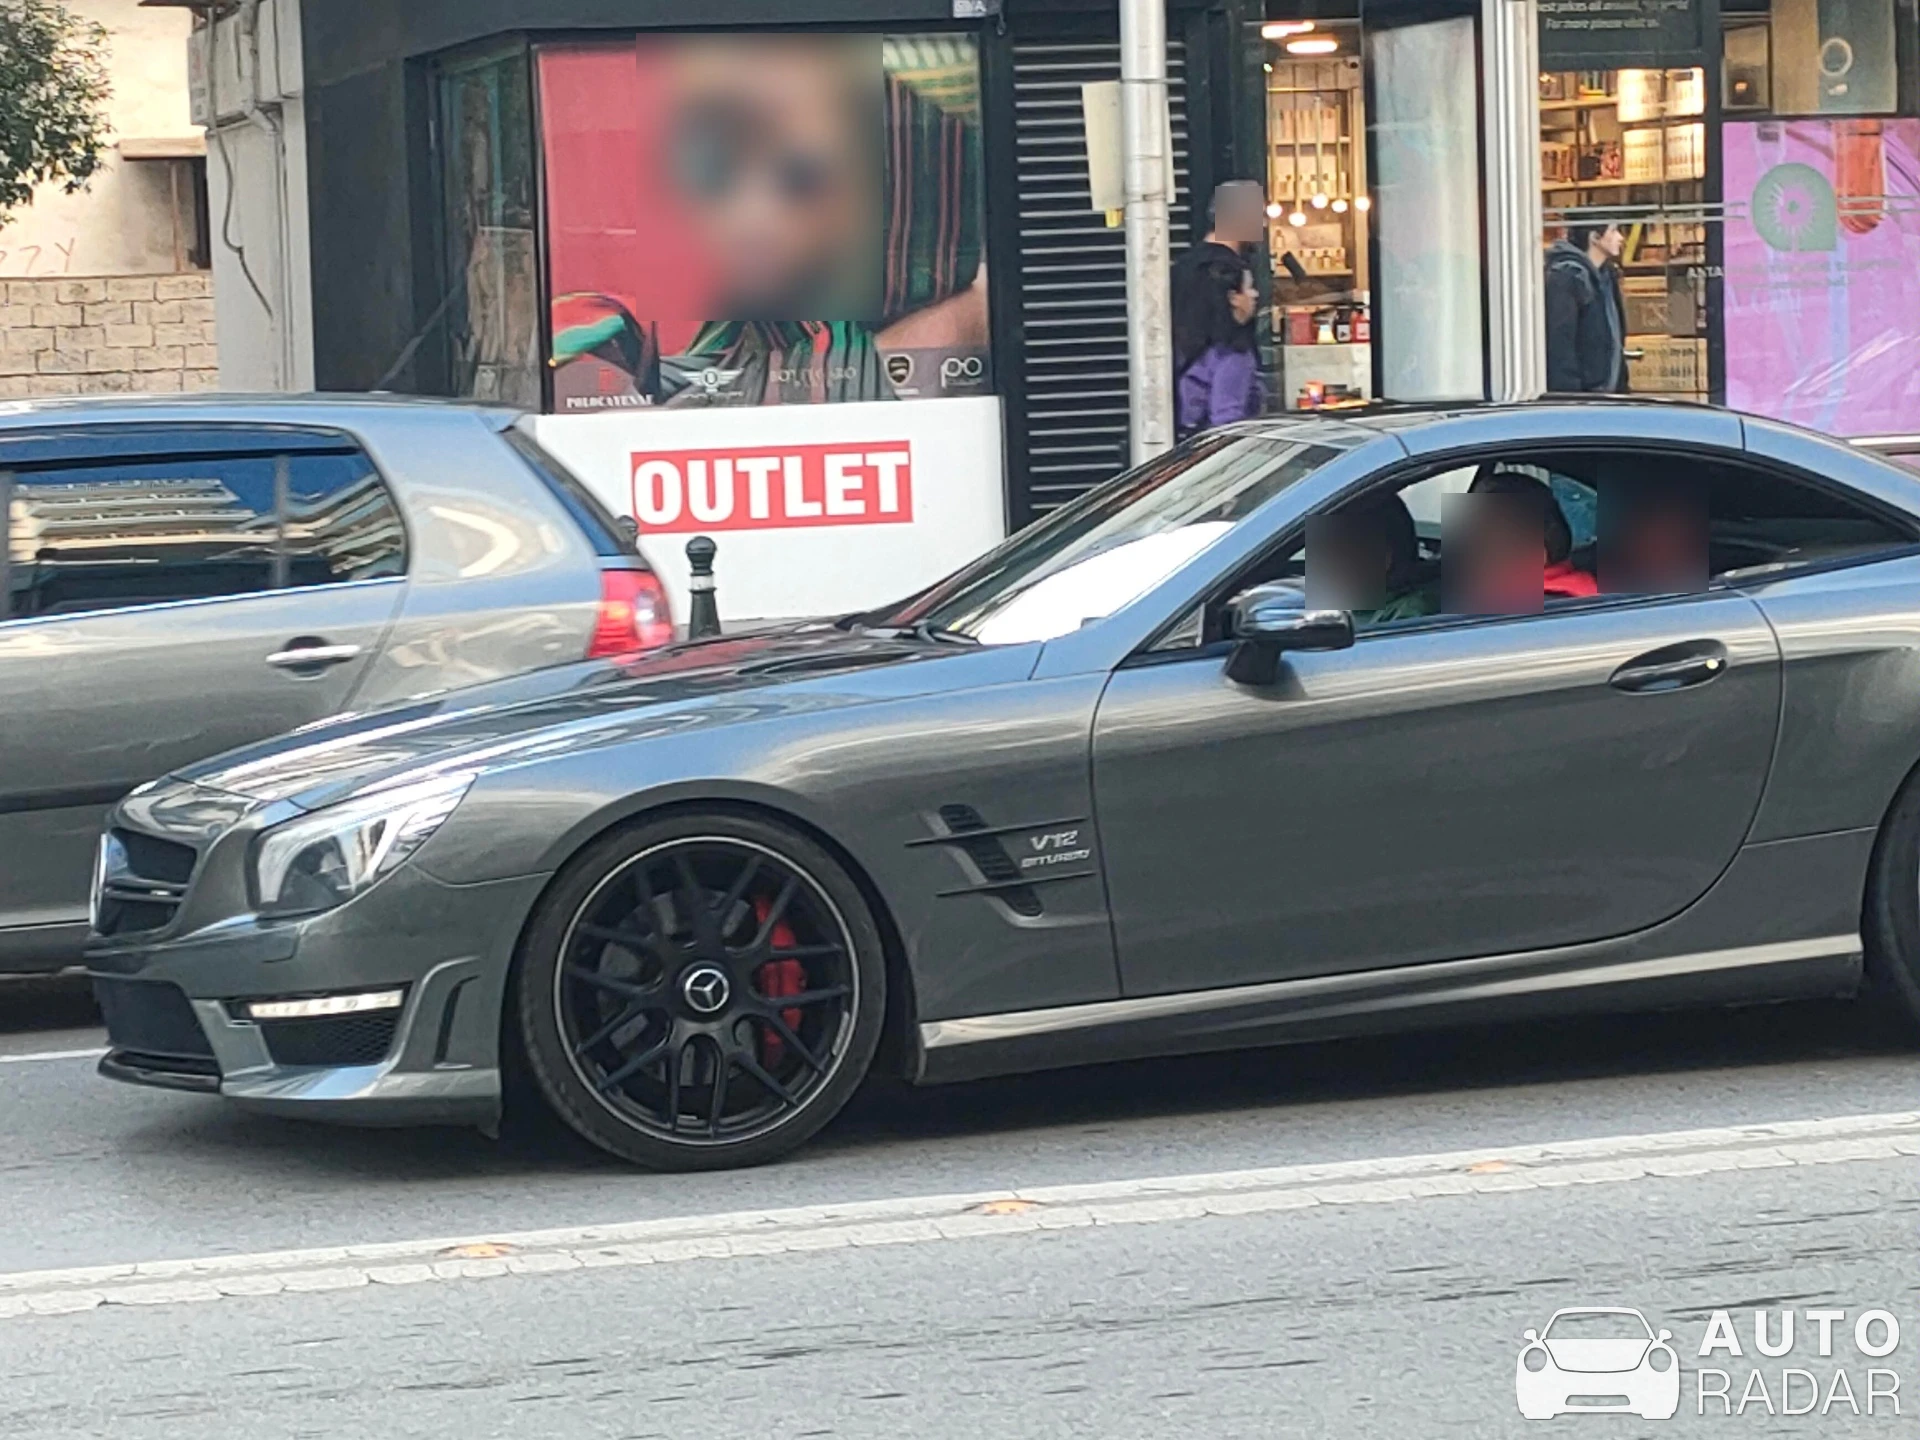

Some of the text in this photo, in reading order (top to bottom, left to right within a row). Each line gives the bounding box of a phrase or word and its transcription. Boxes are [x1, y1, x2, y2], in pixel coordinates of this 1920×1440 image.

[634, 452, 910, 525] OUTLET
[1030, 829, 1078, 851] V12
[1021, 848, 1091, 868] BITURBO
